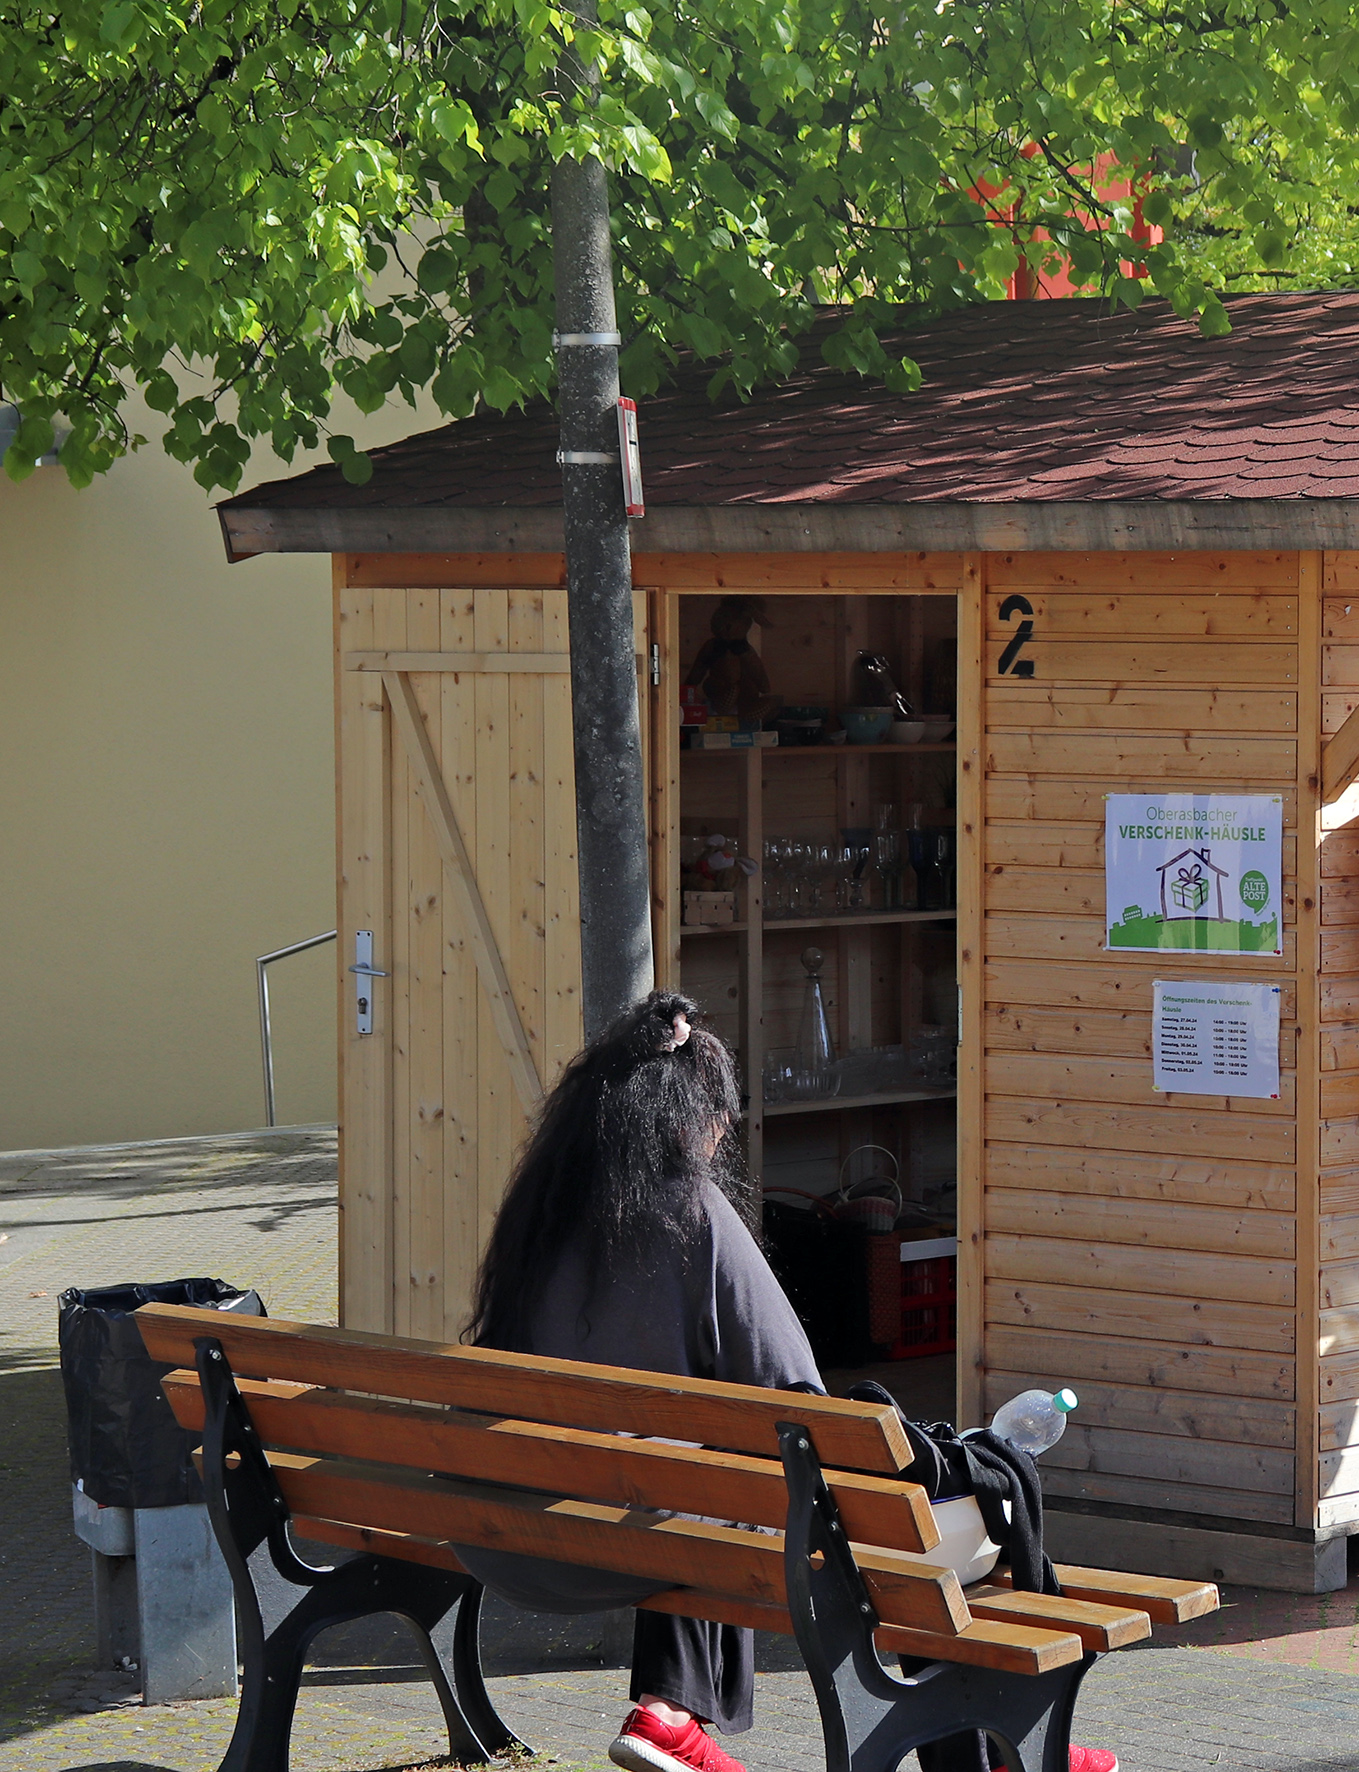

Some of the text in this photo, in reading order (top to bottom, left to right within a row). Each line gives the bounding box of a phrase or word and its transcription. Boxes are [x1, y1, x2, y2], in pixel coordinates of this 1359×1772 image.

[998, 594, 1035, 675] 2
[1146, 806, 1238, 821] Oberasbacher
[1119, 823, 1266, 842] VERSCHENK-HÄUSLE
[1243, 882, 1266, 891] ALTE
[1243, 891, 1266, 901] POST
[1162, 995, 1205, 1004] Öffnungszeiten
